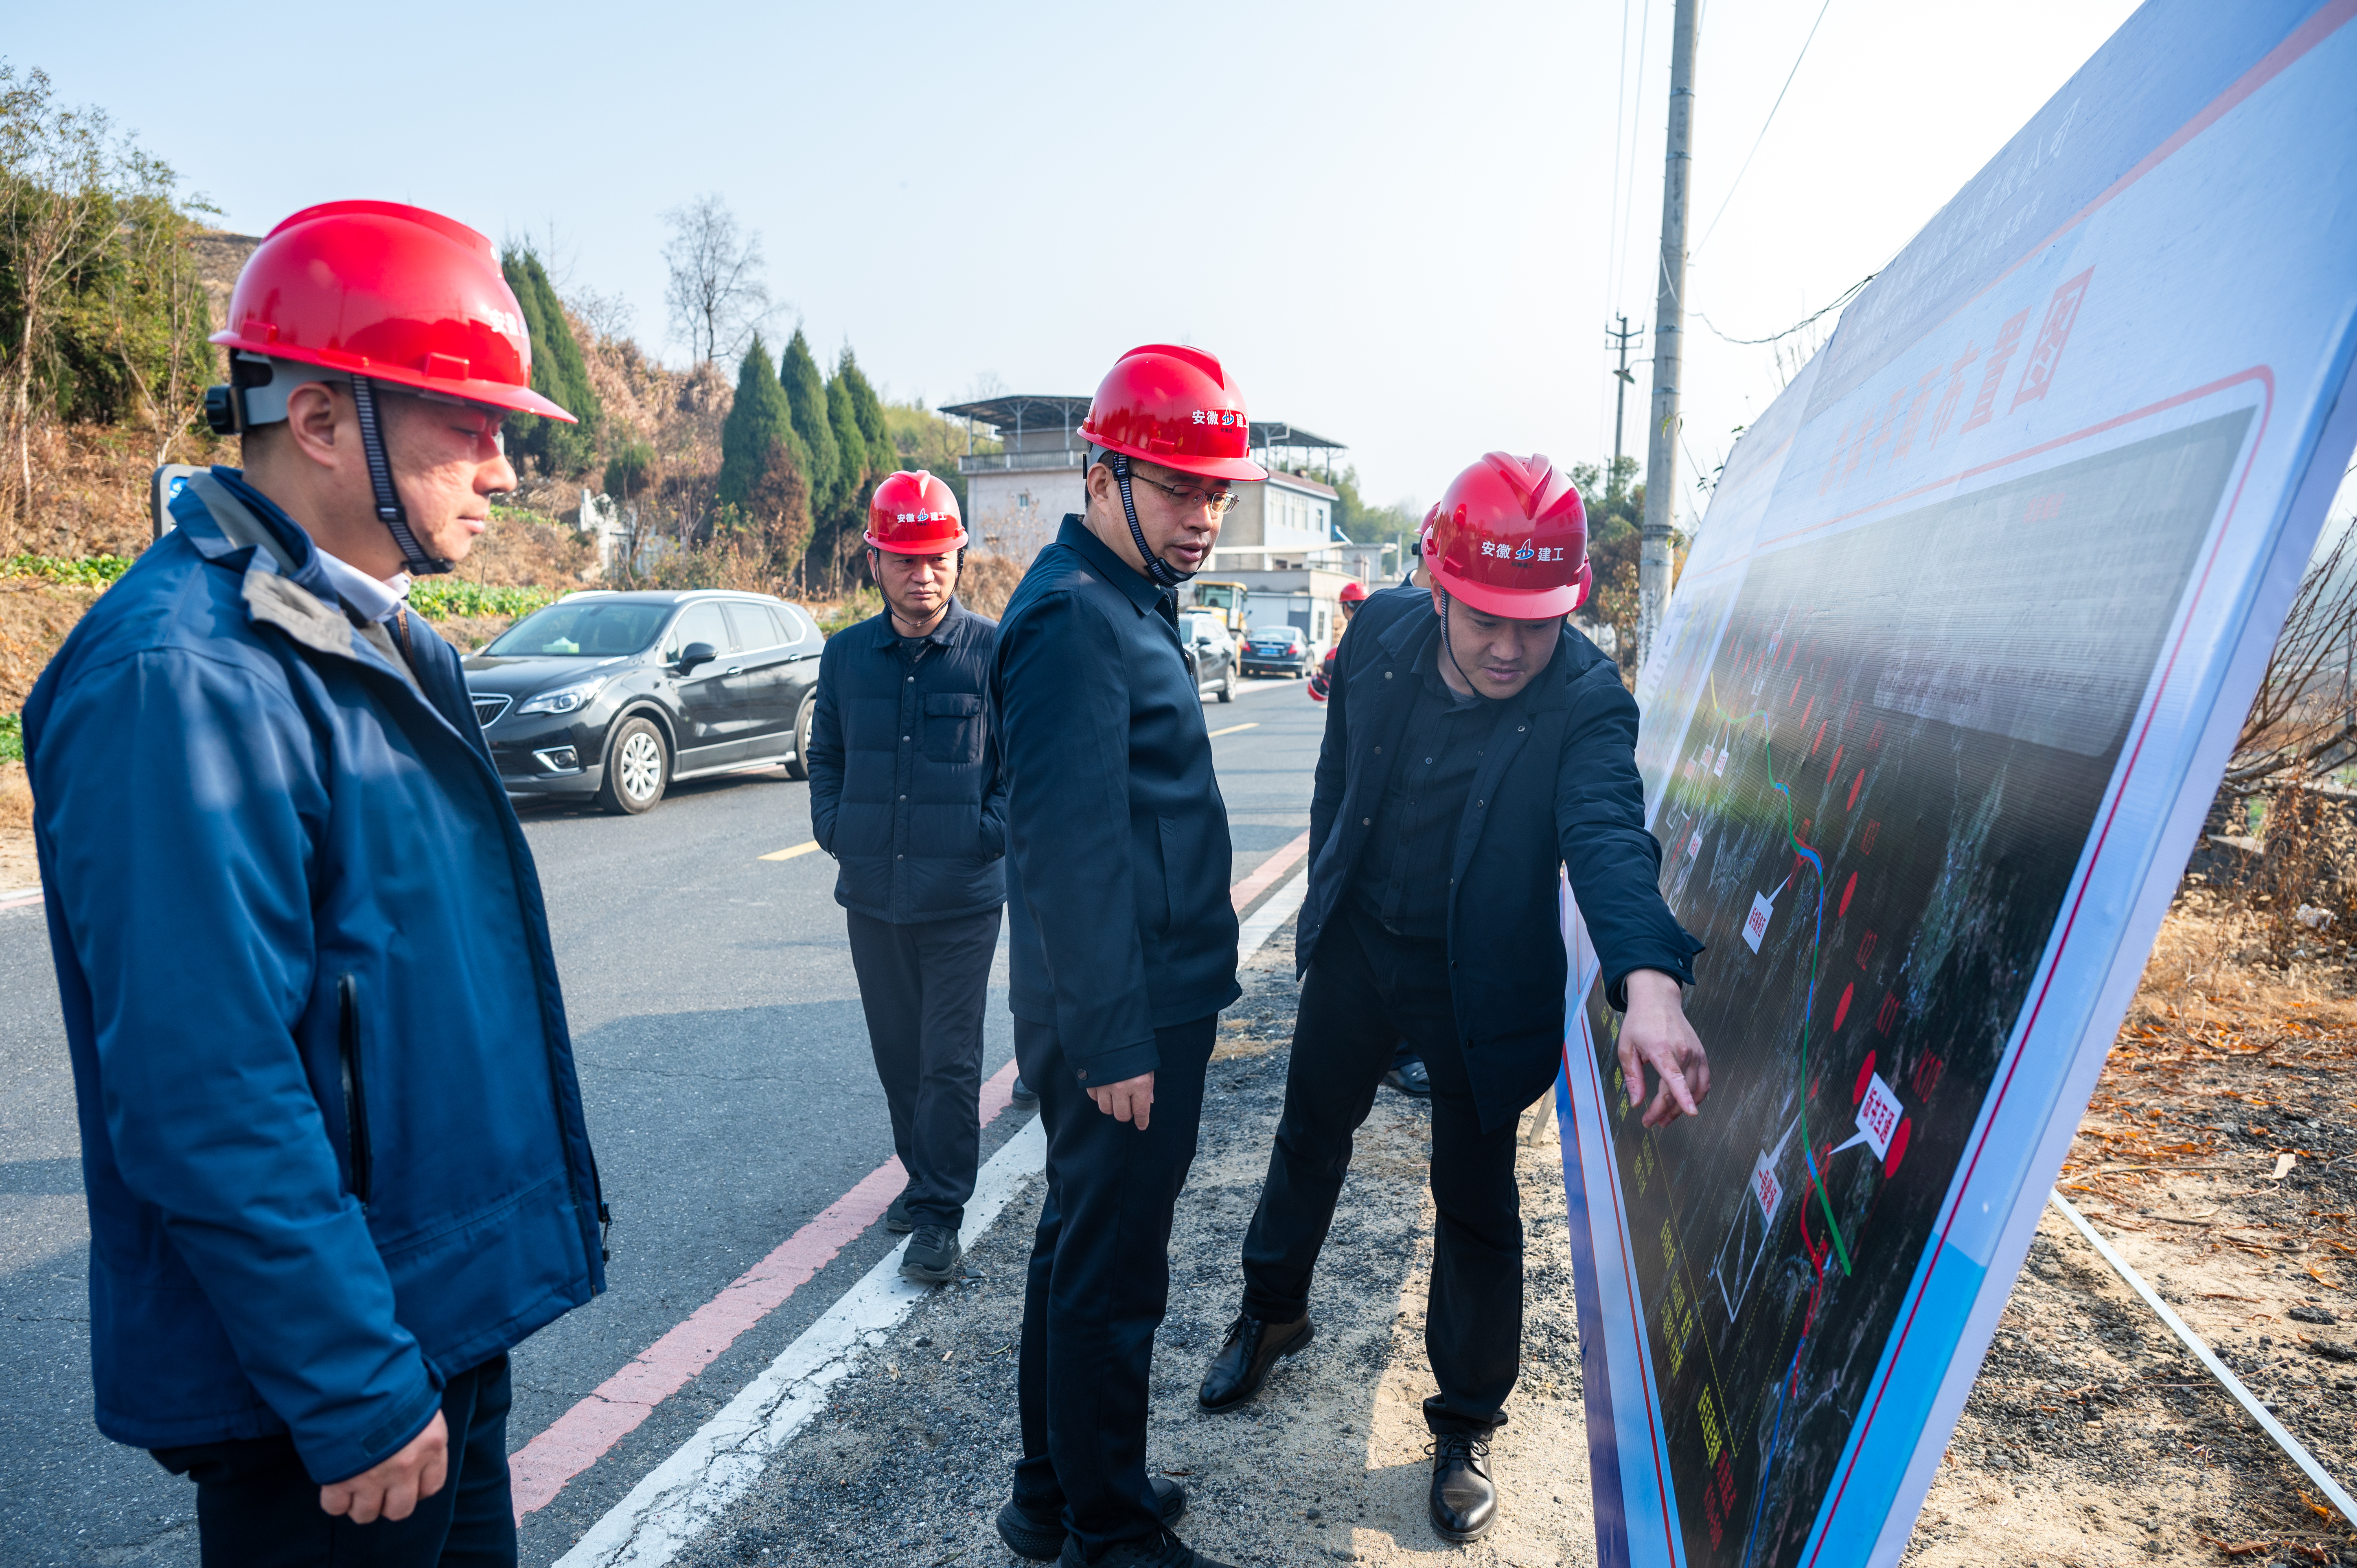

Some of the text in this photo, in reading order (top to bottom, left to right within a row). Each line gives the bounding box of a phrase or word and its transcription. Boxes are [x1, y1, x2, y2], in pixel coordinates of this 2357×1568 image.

[1817, 263, 2096, 497] 总体平面布置图
[1192, 410, 1249, 428] 安徽 建工
[897, 511, 947, 523] 安徽 建工
[1481, 541, 1564, 562] 安徽 建工
[1860, 820, 1880, 855] K13
[1748, 905, 1766, 938] 版书服务区
[1855, 928, 1877, 970] K12
[1876, 990, 1900, 1038] K11
[1912, 1047, 1942, 1104] K10
[1862, 1086, 1895, 1146] 版书互通
[1758, 1169, 1777, 1215] 一号梁场
[1660, 1217, 1676, 1271] 版书特大桥
[1681, 1308, 1693, 1343] 里方
[1669, 1332, 1683, 1379] 村大桥
[1698, 1383, 1722, 1469] 版书互通主线桥
[1716, 1450, 1737, 1520] 项目起点
